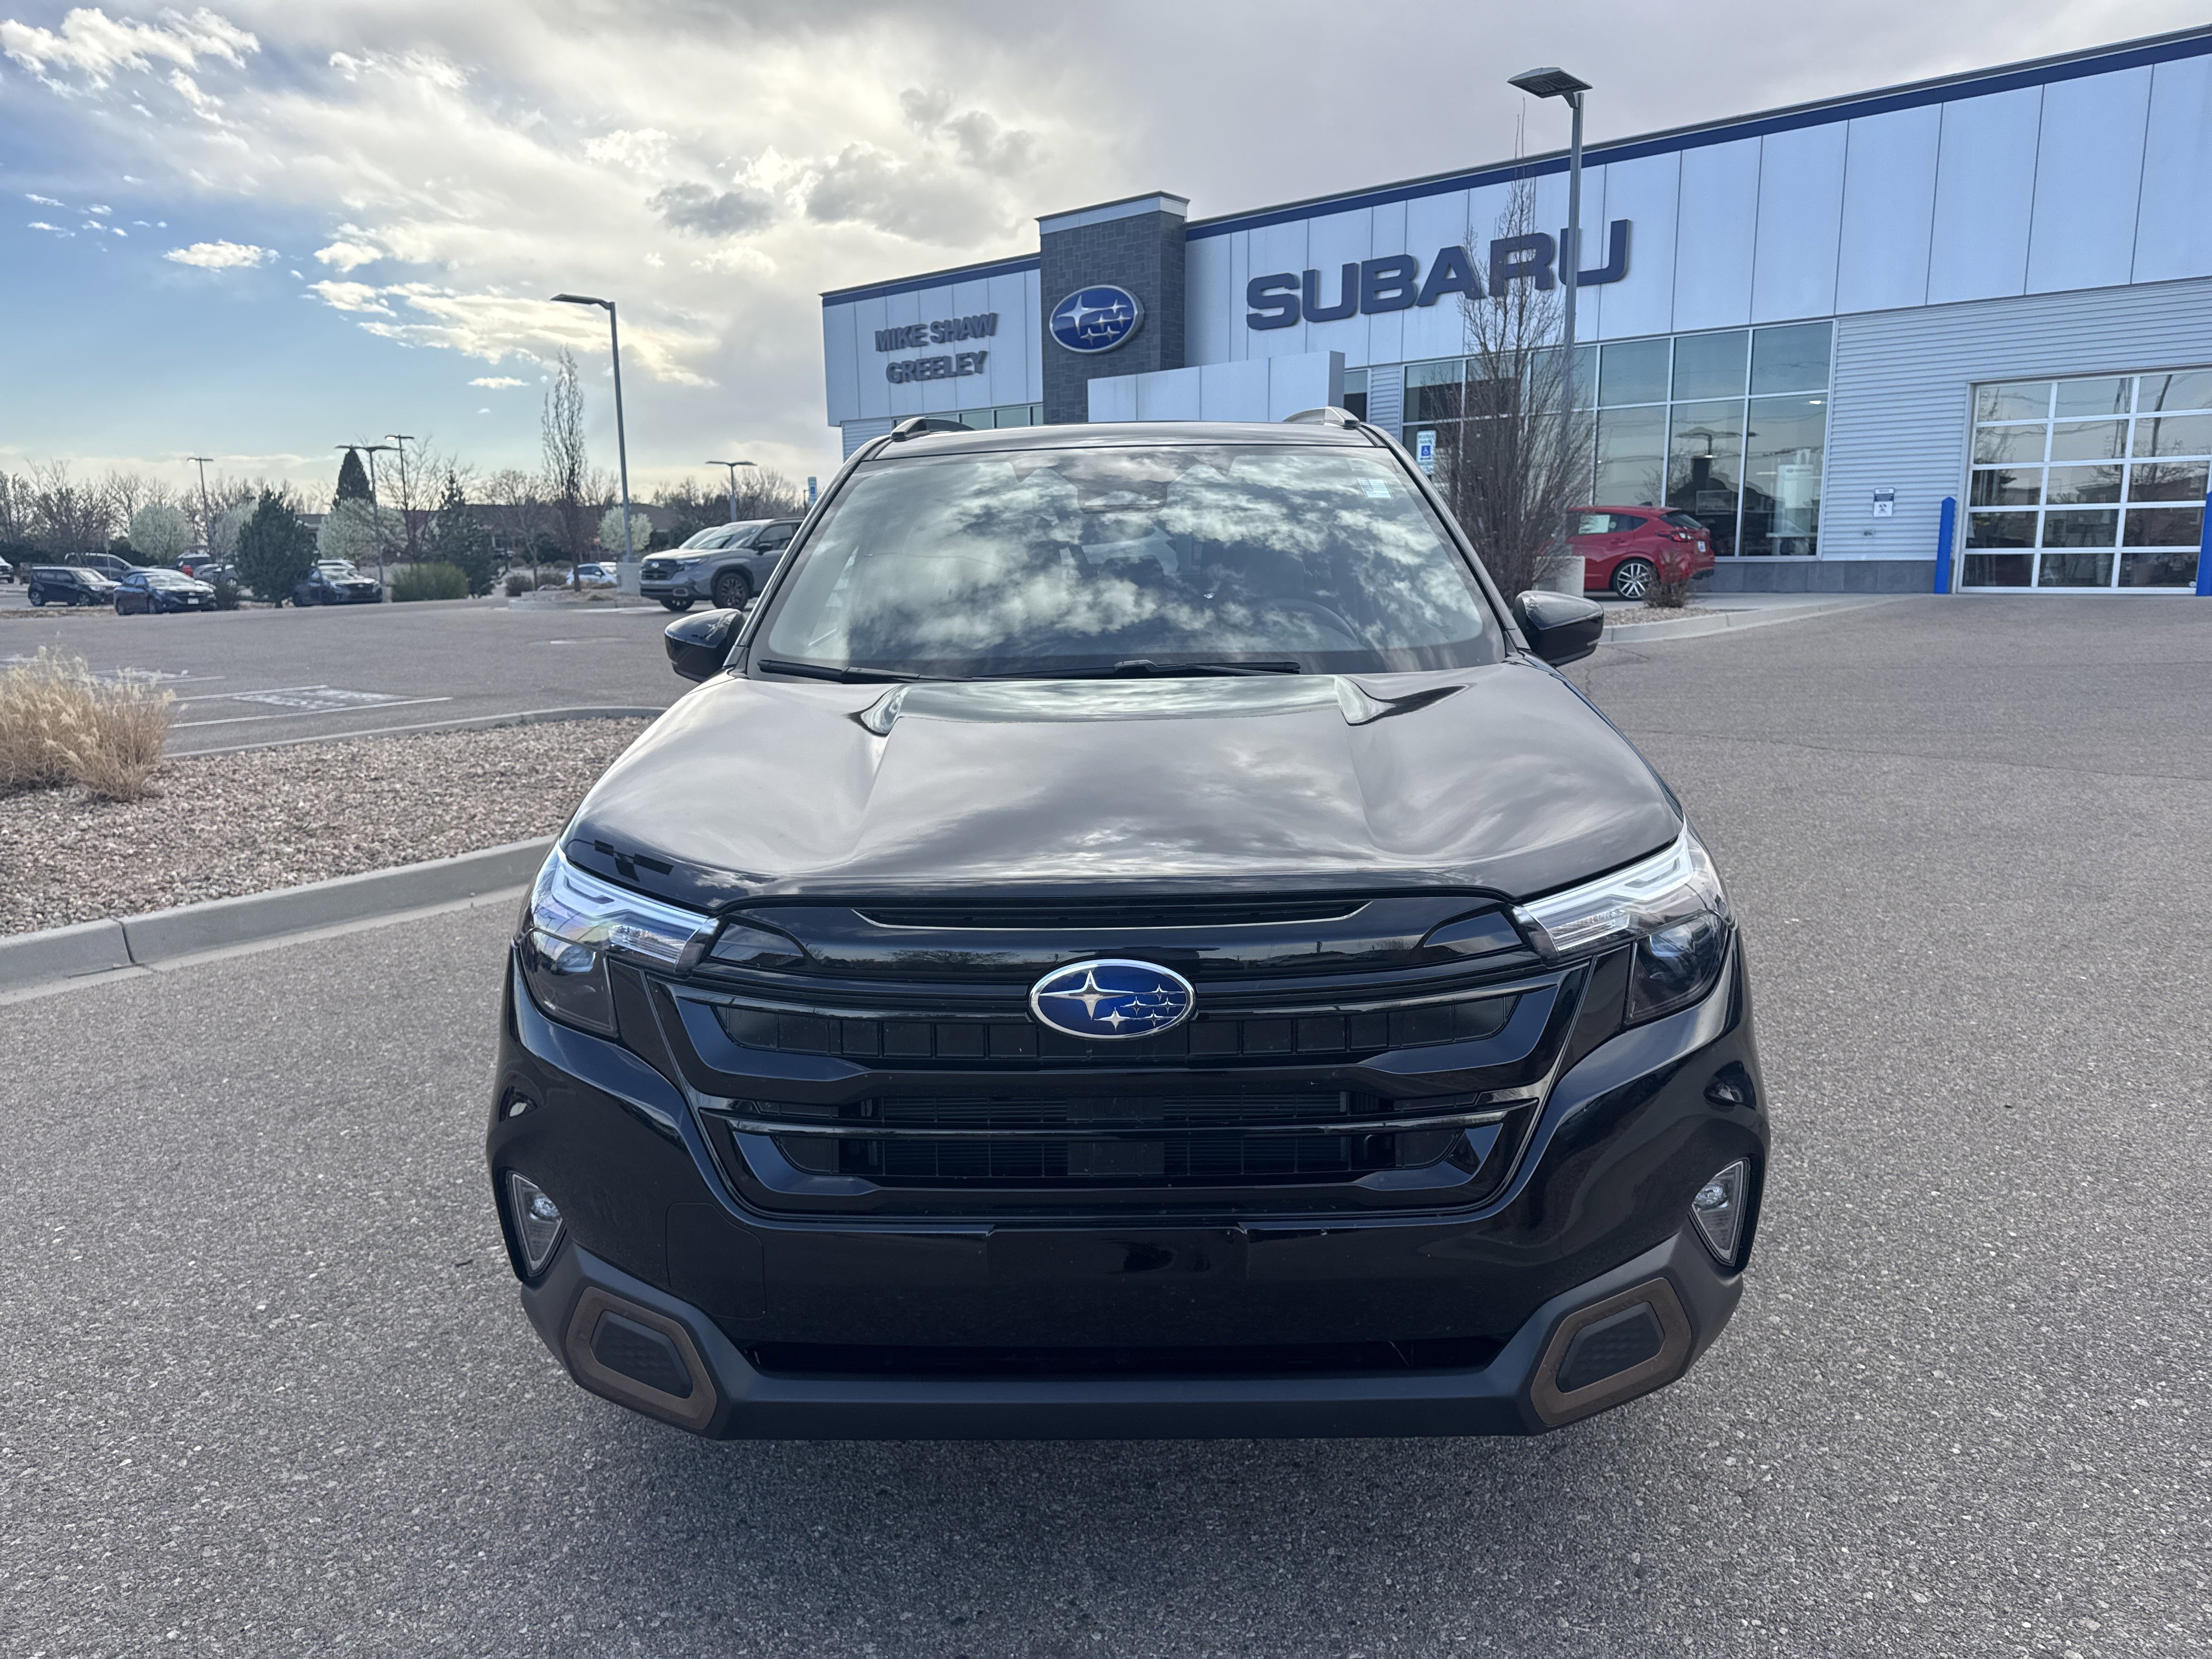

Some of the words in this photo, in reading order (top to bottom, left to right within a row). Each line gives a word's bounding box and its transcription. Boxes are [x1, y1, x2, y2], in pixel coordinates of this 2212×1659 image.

[1246, 219, 1632, 330] SUBARU
[875, 324, 928, 352] MIKE
[929, 313, 998, 343] SHAW
[886, 351, 987, 383] GREELEY
